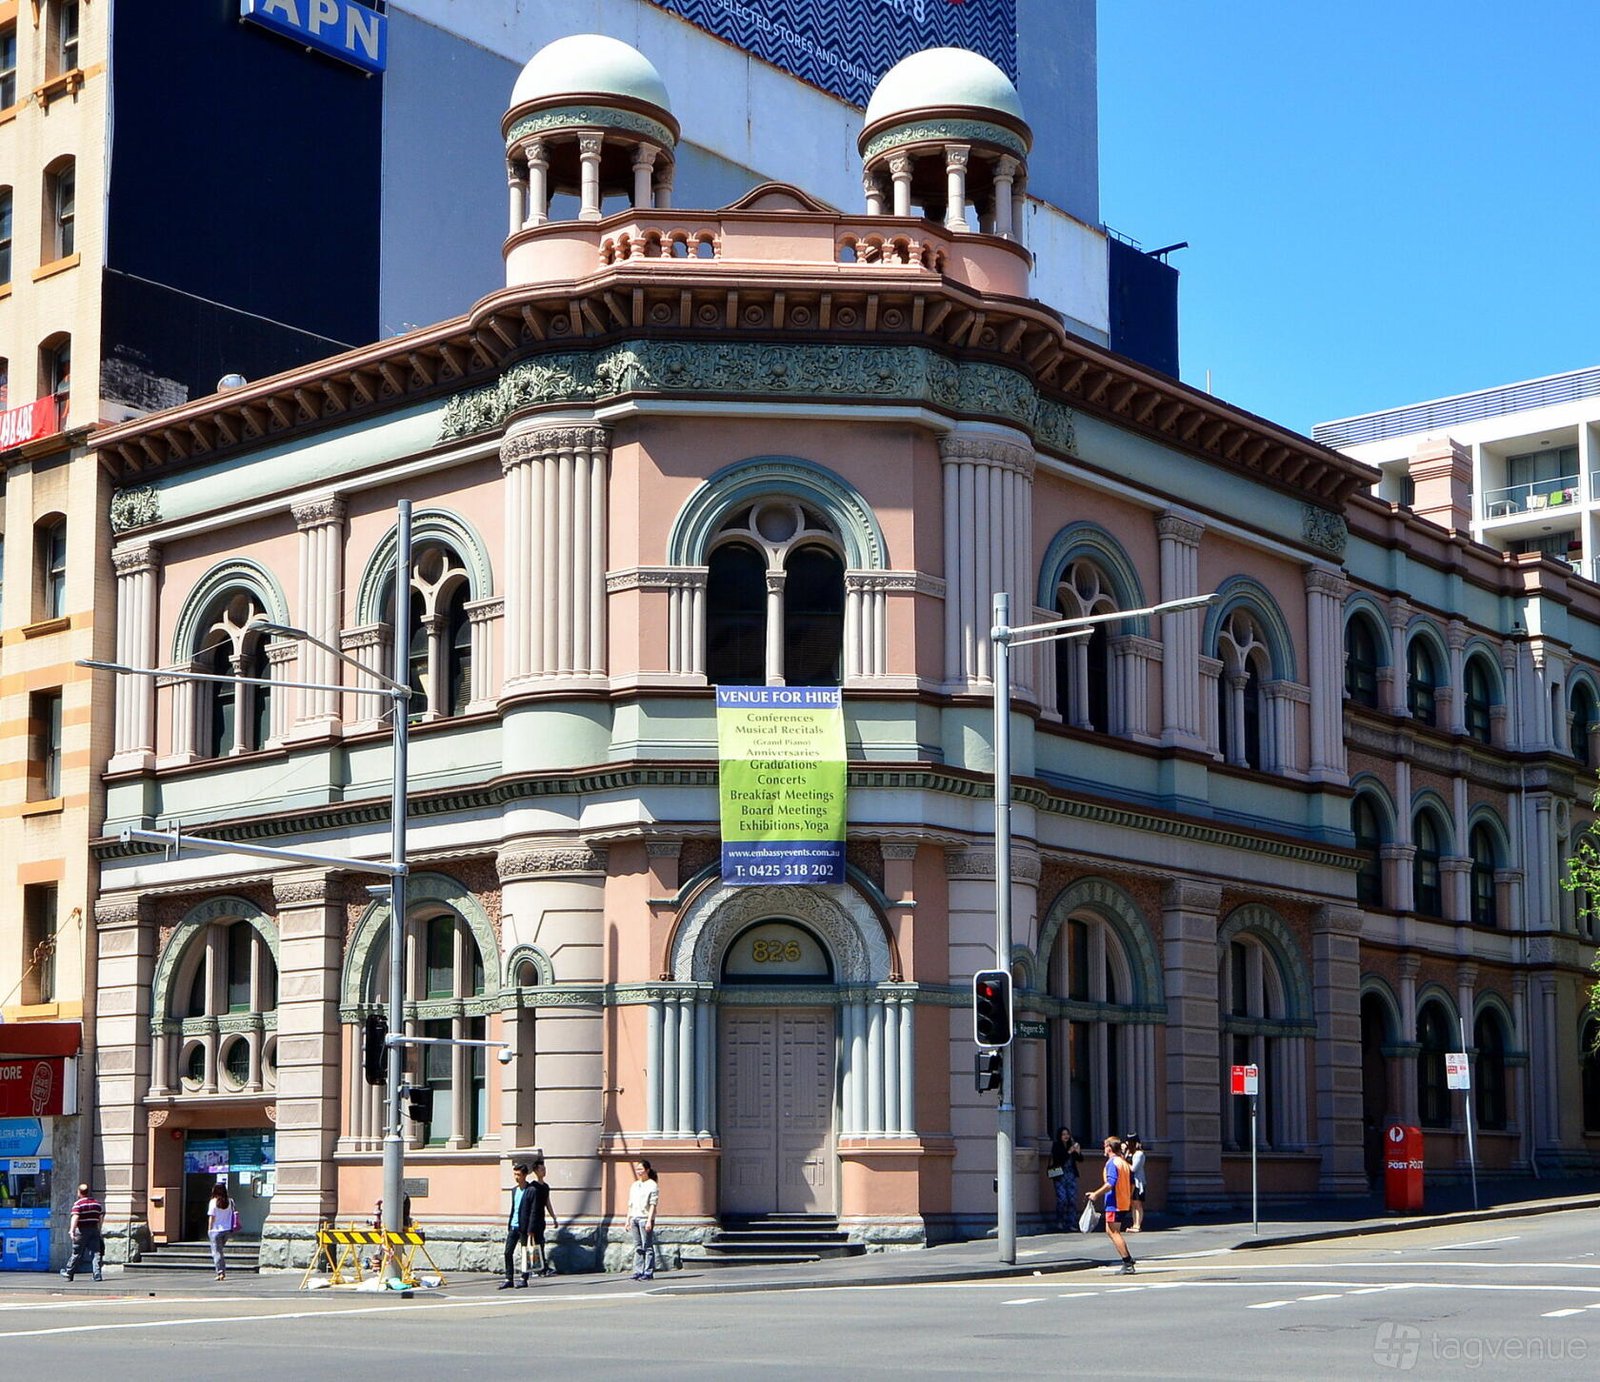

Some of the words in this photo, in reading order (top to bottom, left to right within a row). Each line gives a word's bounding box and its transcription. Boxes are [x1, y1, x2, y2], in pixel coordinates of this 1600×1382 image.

[717, 0, 771, 31] SELECTED
[773, 23, 813, 54] STORES
[815, 46, 838, 66] AND
[840, 59, 878, 87] ONLINE
[720, 691, 768, 703] VENUE
[773, 691, 802, 703] FOR
[806, 691, 840, 703] HIRE
[747, 713, 814, 723] Conferences
[735, 725, 777, 735] Musical
[781, 725, 824, 735] Recitals
[746, 748, 820, 757] Anniversaries
[750, 760, 818, 769] Graduations
[757, 774, 806, 785] Concerts
[730, 789, 781, 800] Breakfast
[784, 789, 834, 803] Meetings
[741, 805, 774, 816] Board
[777, 804, 827, 818] Meetings
[728, 848, 840, 858] www.embassyevents.com.au
[735, 865, 746, 877] T:
[749, 865, 780, 876] 0425
[784, 864, 808, 876] 318
[811, 864, 834, 876] 202
[752, 939, 801, 962] 826
[1387, 1161, 1408, 1169] POST
[1408, 1160, 1424, 1169] POST
